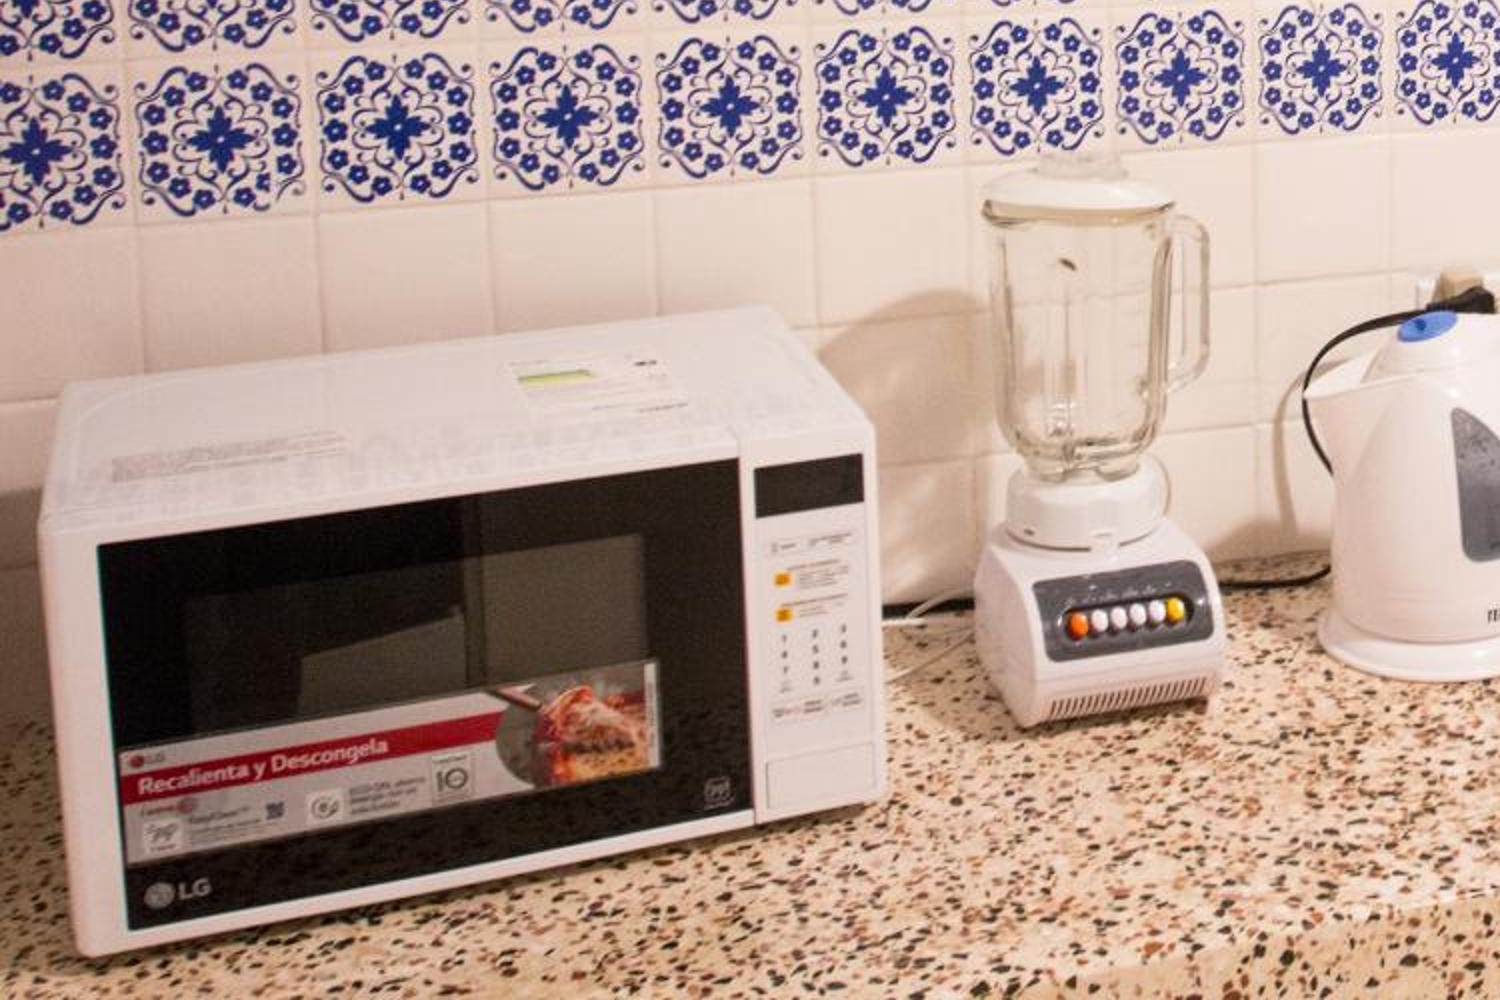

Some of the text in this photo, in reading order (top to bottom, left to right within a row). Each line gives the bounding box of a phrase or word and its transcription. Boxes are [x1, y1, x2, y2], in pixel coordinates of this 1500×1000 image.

[137, 738, 389, 796] Recalienta y Descongela
[178, 878, 212, 901] LG
